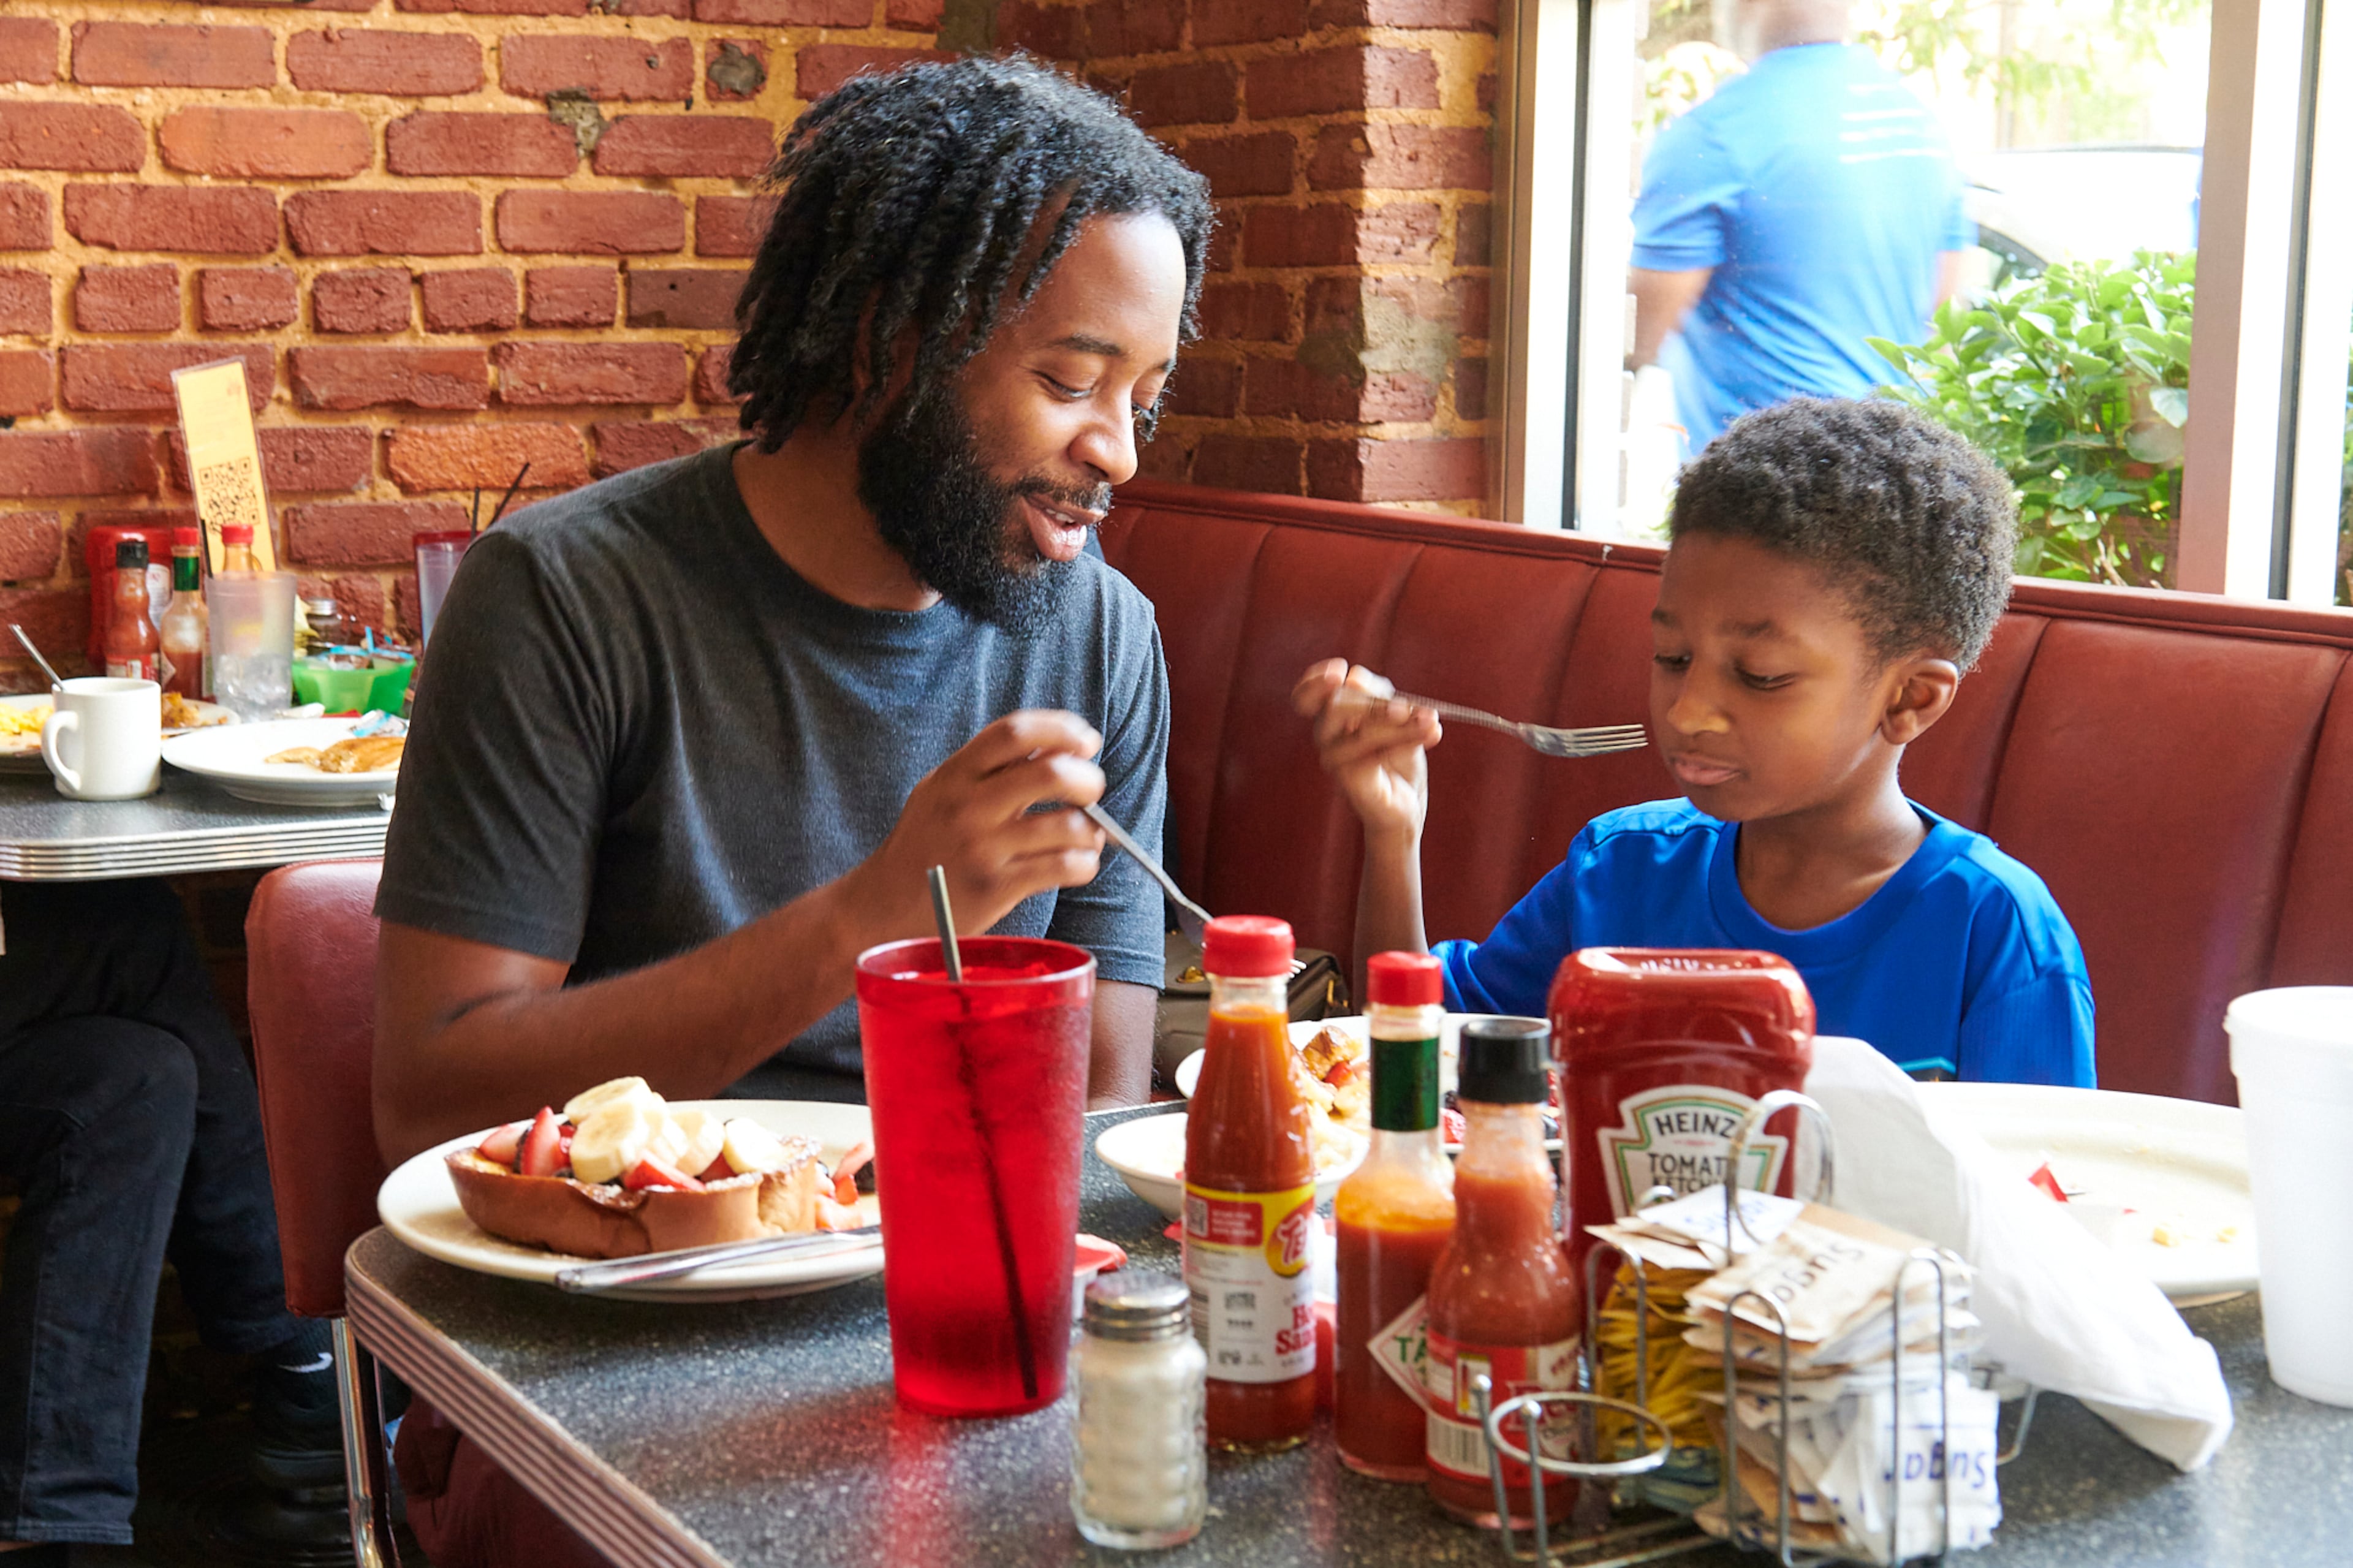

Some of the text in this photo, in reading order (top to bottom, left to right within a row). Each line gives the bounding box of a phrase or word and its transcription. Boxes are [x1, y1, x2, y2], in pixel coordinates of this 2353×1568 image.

[1654, 1112, 1736, 1138] HEINZ
[1648, 1152, 1729, 1176] TOMAT
[1771, 1243, 1865, 1303] Suga
[1883, 1441, 1988, 1489] Suga
